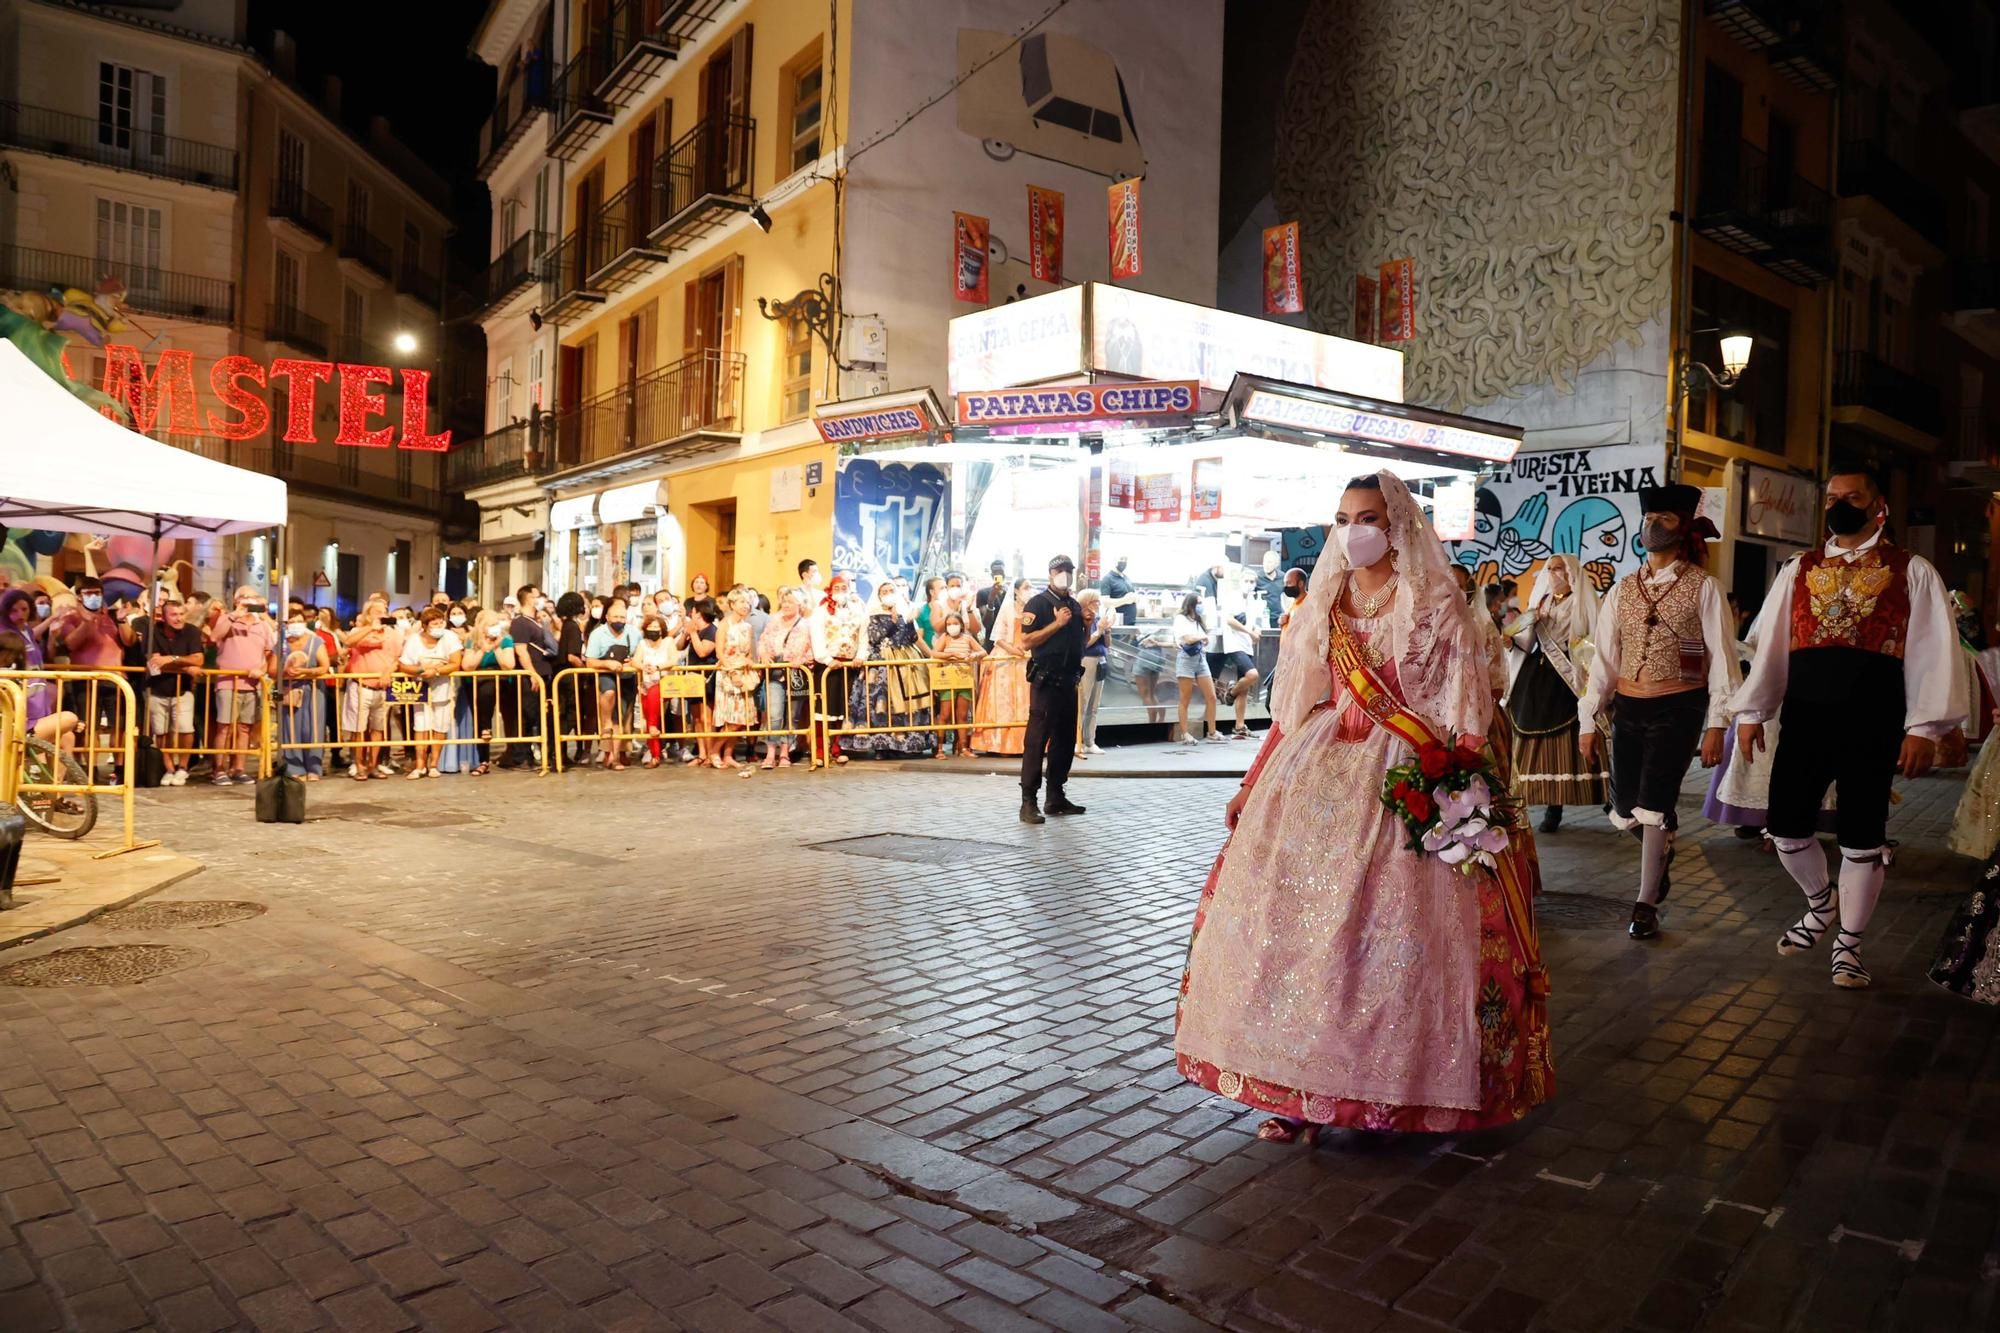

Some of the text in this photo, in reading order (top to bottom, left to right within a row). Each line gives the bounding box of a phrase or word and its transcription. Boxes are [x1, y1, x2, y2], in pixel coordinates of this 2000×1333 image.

[1286, 227, 1295, 273] PATATAS
[61, 344, 452, 453] MSTEL
[968, 386, 1191, 417] PATATAS CHIPS
[823, 409, 920, 439] SANDWICHES
[1250, 395, 1411, 441] HAMBURGUESAS
[391, 681, 423, 694] SPV
